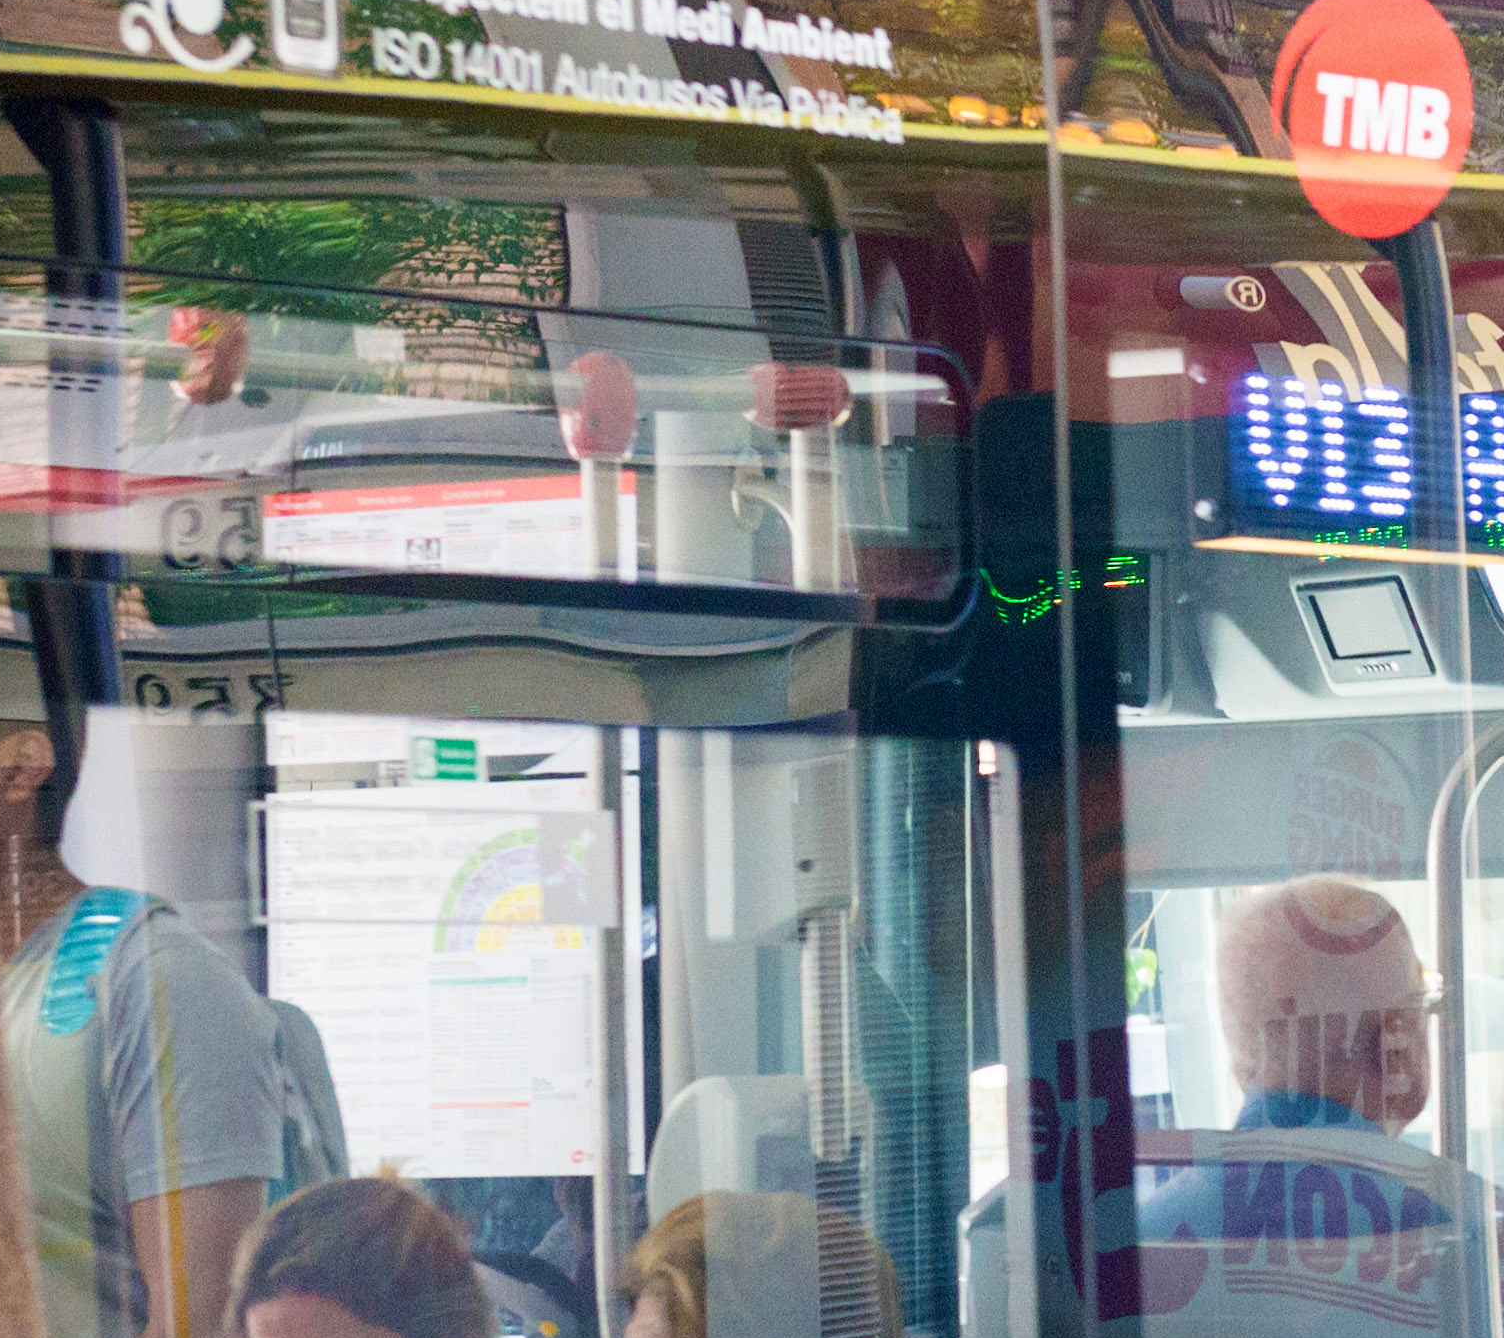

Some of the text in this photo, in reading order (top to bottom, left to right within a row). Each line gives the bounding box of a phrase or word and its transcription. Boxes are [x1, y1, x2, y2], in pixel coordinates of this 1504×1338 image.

[373, 27, 441, 80] ISO
[448, 38, 544, 95] 14001
[552, 51, 729, 122] Autobusos
[741, 7, 895, 72] Ambient
[1315, 71, 1451, 161] TMB
[1245, 372, 1412, 519] V13
